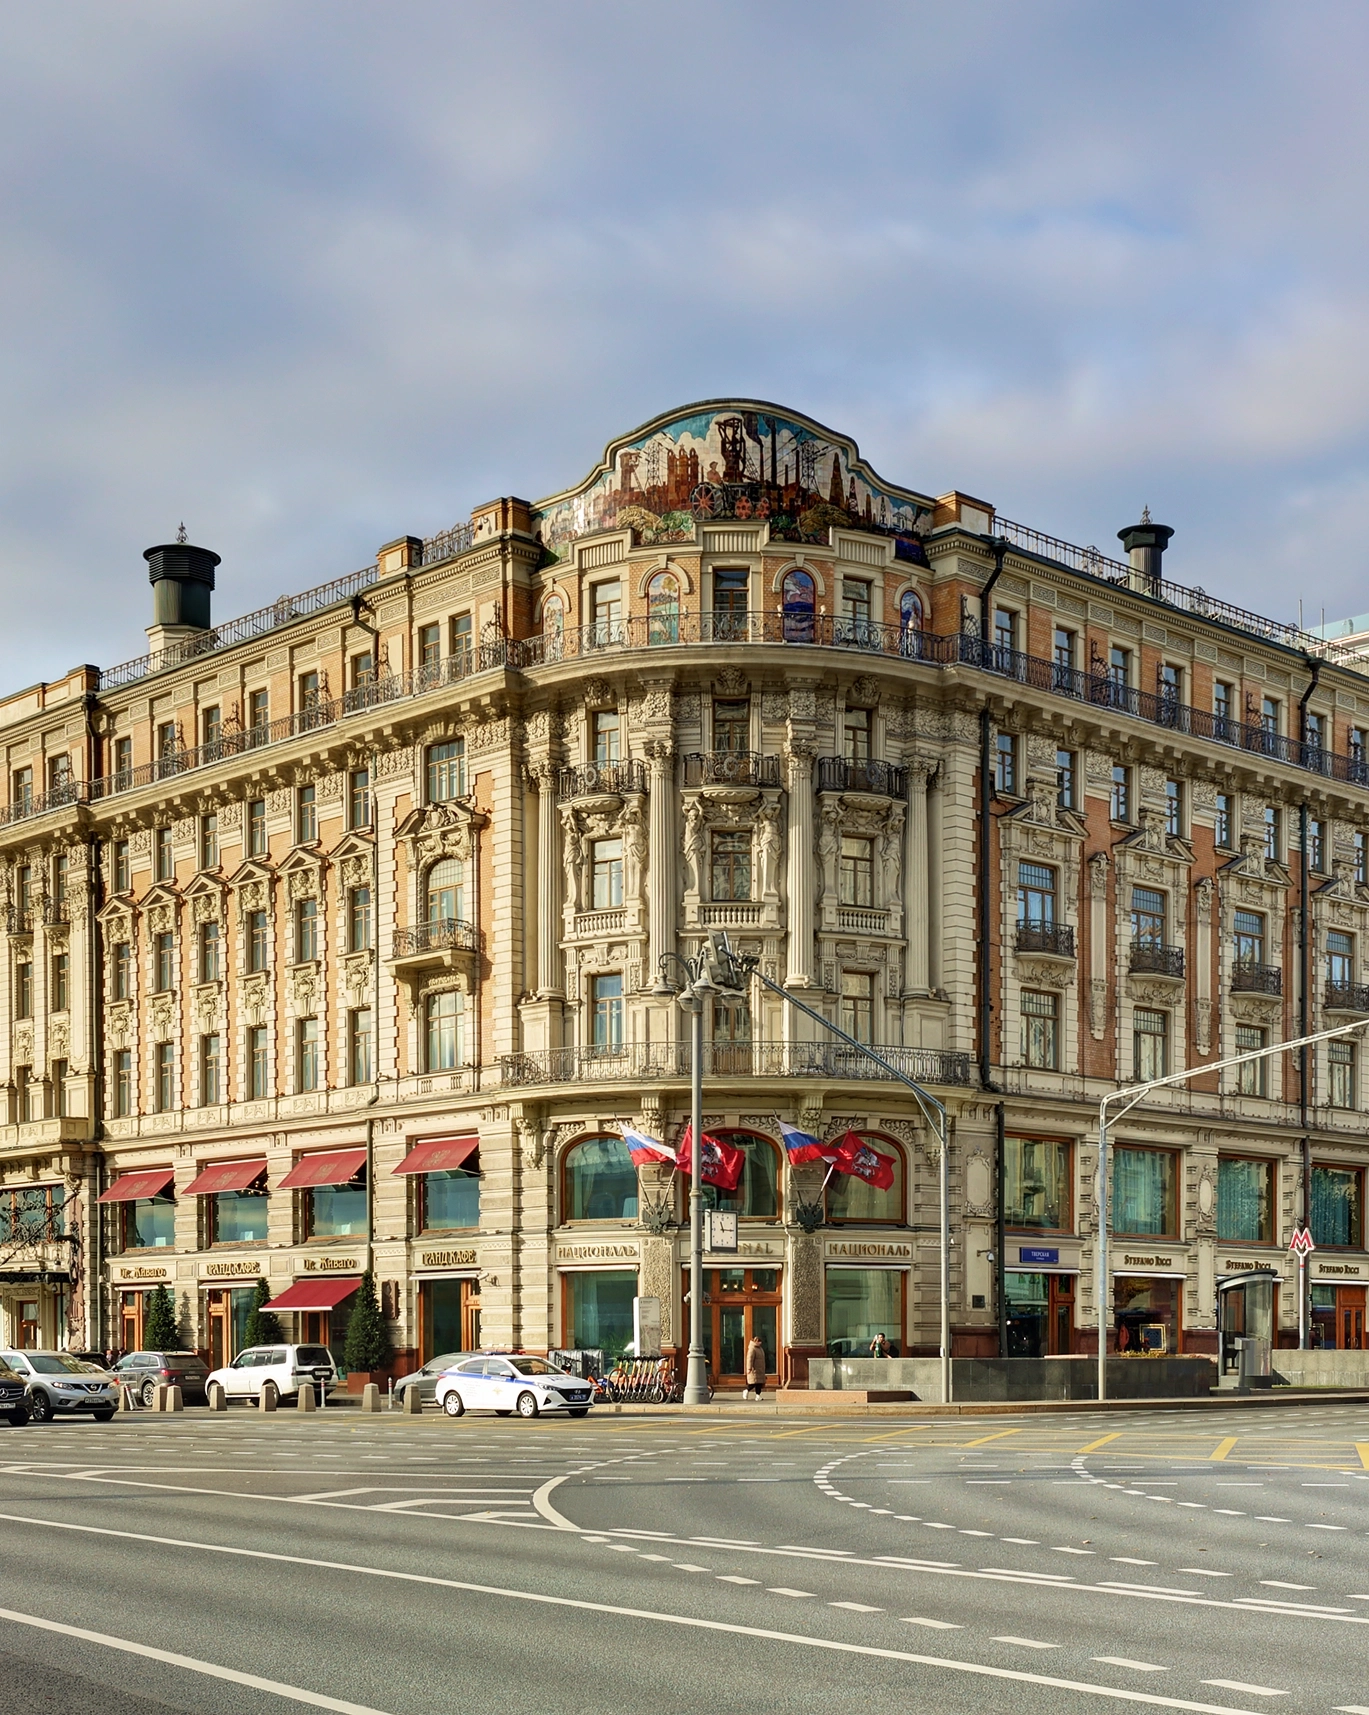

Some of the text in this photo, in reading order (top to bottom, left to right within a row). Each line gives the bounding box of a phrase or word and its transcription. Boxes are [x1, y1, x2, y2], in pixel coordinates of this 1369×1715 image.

[558, 1244, 638, 1259] НАЦИОНАЛЬ
[829, 1243, 911, 1258] НАЦИОНАЛЬ
[320, 1258, 357, 1270] Живаго
[422, 1250, 476, 1266] ГРАНД КАФЕ
[134, 1267, 167, 1278] Живаго
[206, 1263, 232, 1276] ГРАНД
